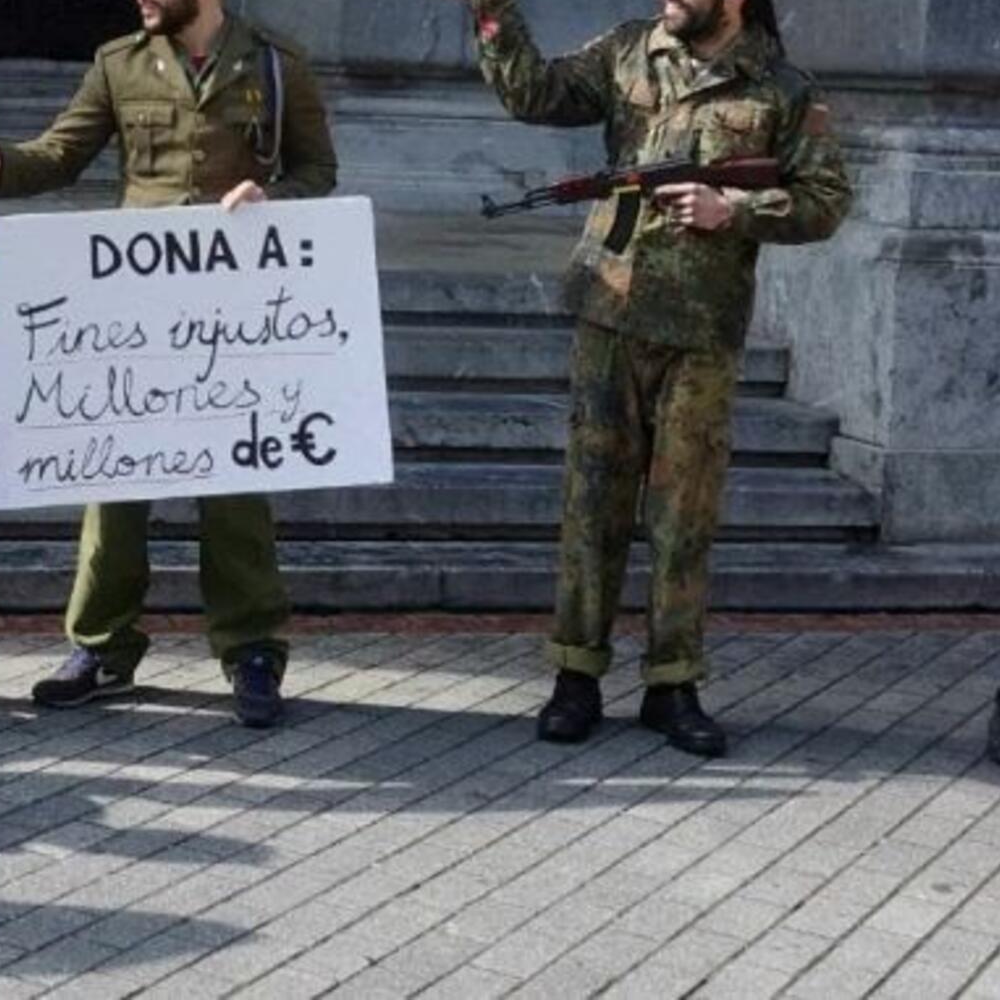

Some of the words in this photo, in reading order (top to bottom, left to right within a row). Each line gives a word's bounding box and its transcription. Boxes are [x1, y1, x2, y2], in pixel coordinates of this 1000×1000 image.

[89, 229, 239, 280] DONA
[257, 224, 314, 270] A:
[17, 295, 149, 362] Fines
[168, 286, 350, 383] injustos,
[16, 365, 262, 425] Millones
[279, 378, 305, 423] y
[20, 435, 215, 484] millones
